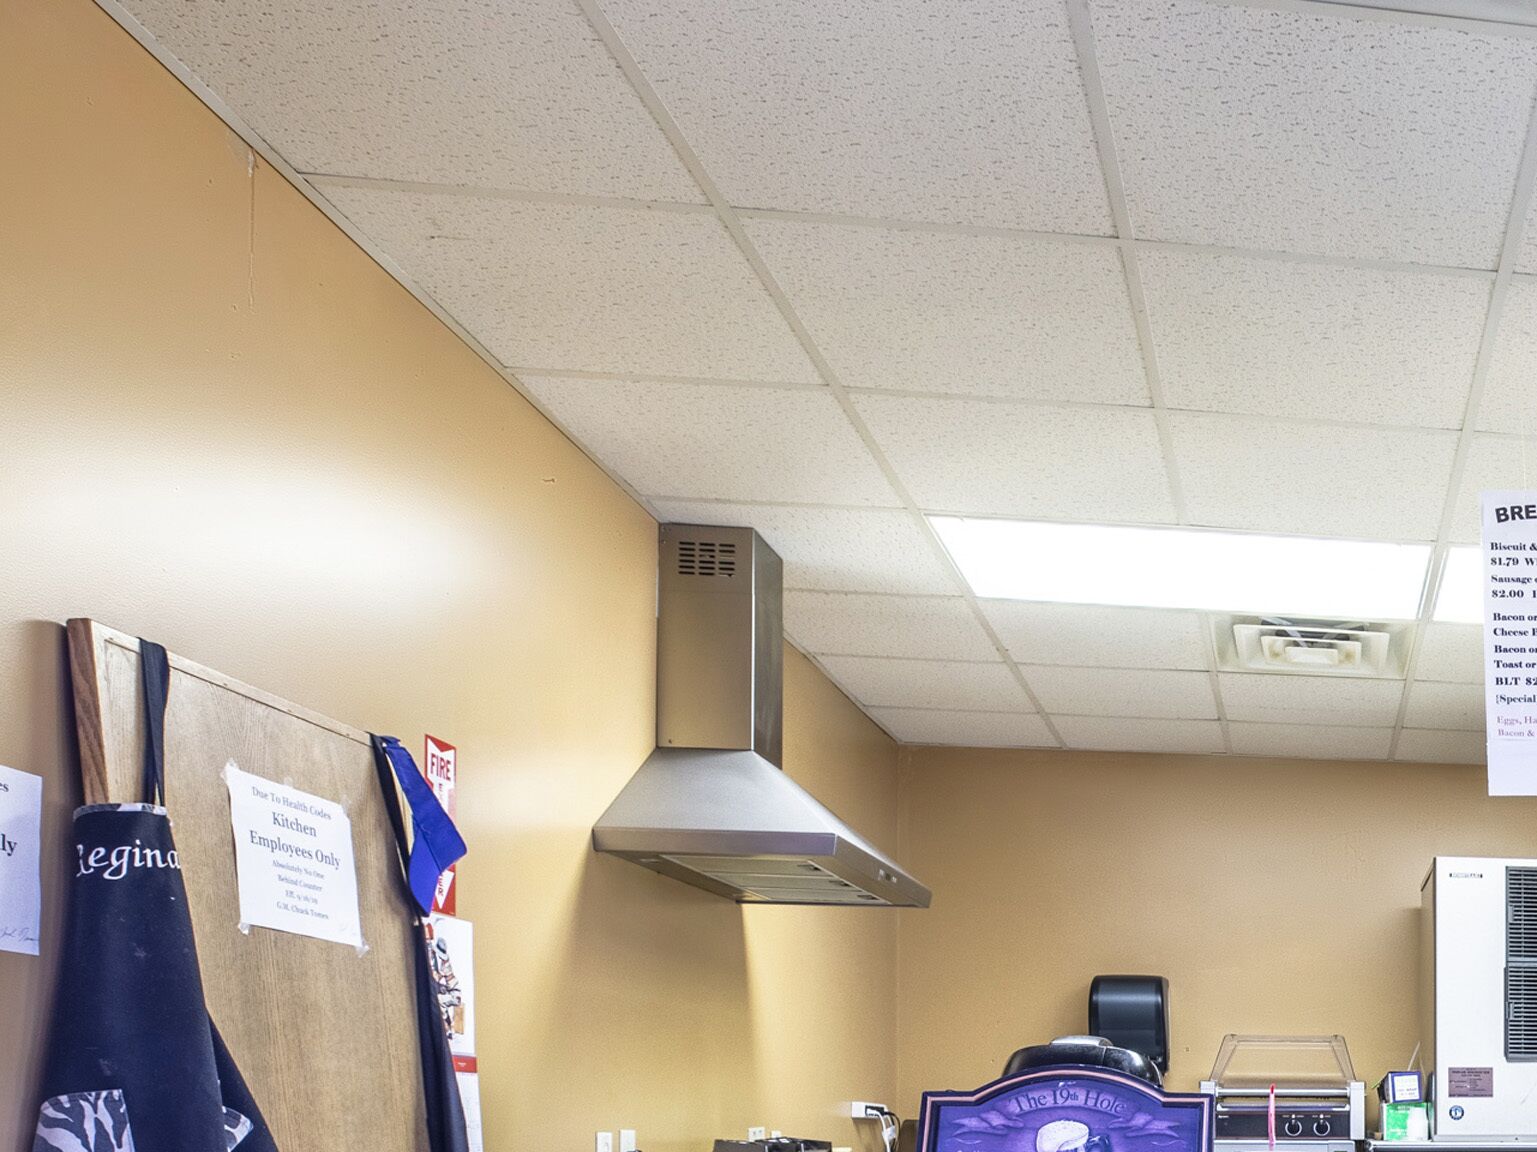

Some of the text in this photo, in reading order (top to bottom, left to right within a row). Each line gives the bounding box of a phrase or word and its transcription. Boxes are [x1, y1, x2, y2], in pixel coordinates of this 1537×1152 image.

[1491, 542, 1526, 551] Biscuit
[1530, 543, 1537, 551] &
[1491, 557, 1519, 567] $1.79
[1491, 575, 1531, 584] Sausage
[1492, 590, 1524, 598] $2.00
[1493, 613, 1525, 622] Bacon
[1493, 628, 1529, 637] Cheese
[1494, 646, 1526, 654] Bacon
[1494, 660, 1522, 669] Toast
[1495, 677, 1521, 686] BLT
[430, 752, 451, 781] FIRE
[252, 786, 332, 820] Due To Health Codes
[272, 811, 317, 838] Kitchen
[250, 829, 341, 871] Employees Only
[1014, 1092, 1047, 1113] The
[1084, 1090, 1125, 1114] Hole
